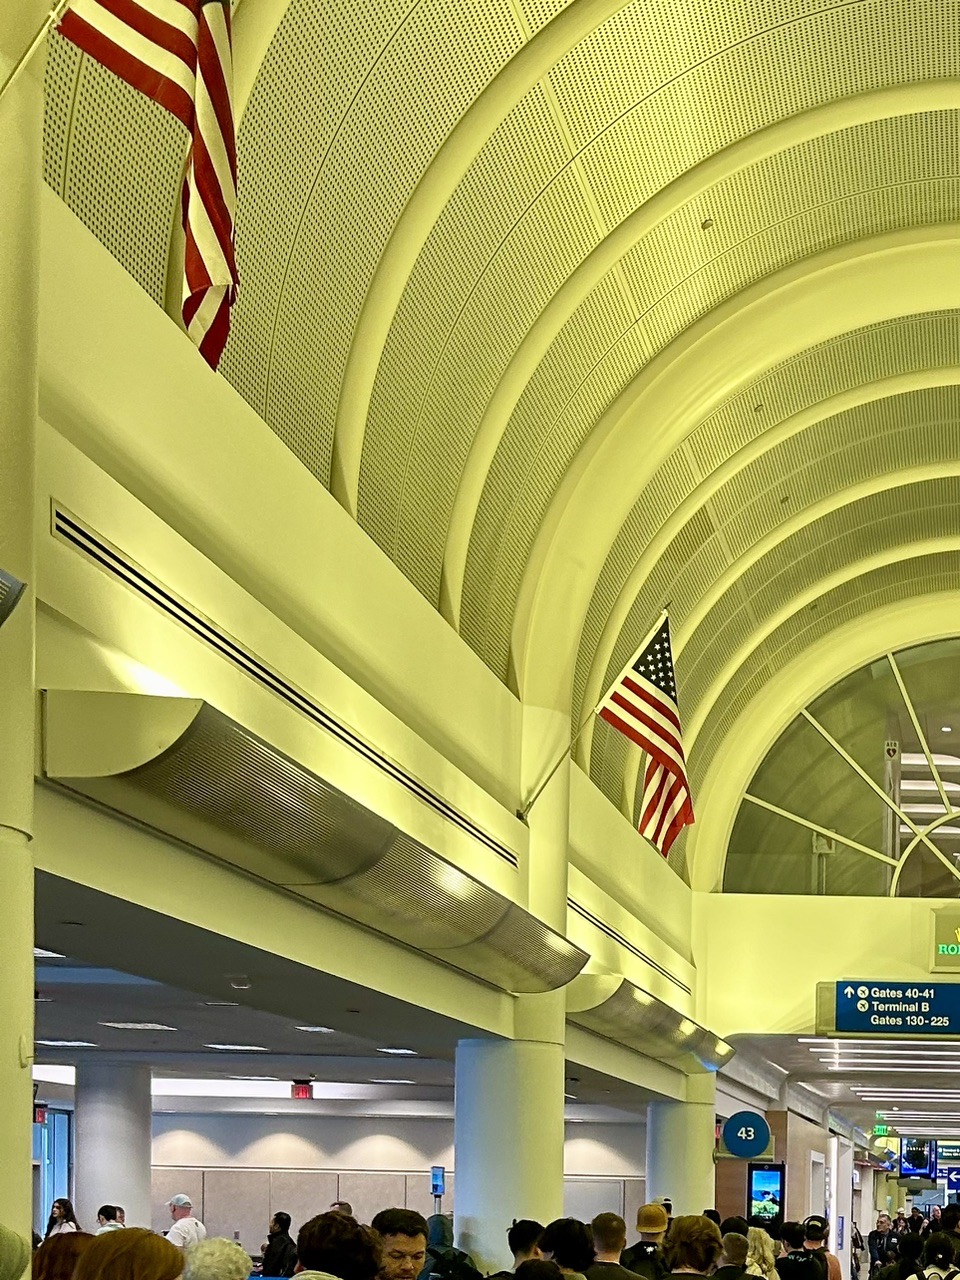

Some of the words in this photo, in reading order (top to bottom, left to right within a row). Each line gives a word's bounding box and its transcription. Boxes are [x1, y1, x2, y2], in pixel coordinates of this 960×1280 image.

[870, 987, 903, 998] Gates
[905, 988, 935, 999] 40-41
[872, 1001, 918, 1012] Terminal
[921, 1002, 930, 1012] B
[870, 1015, 903, 1025] Gates
[737, 1127, 755, 1140] 43
